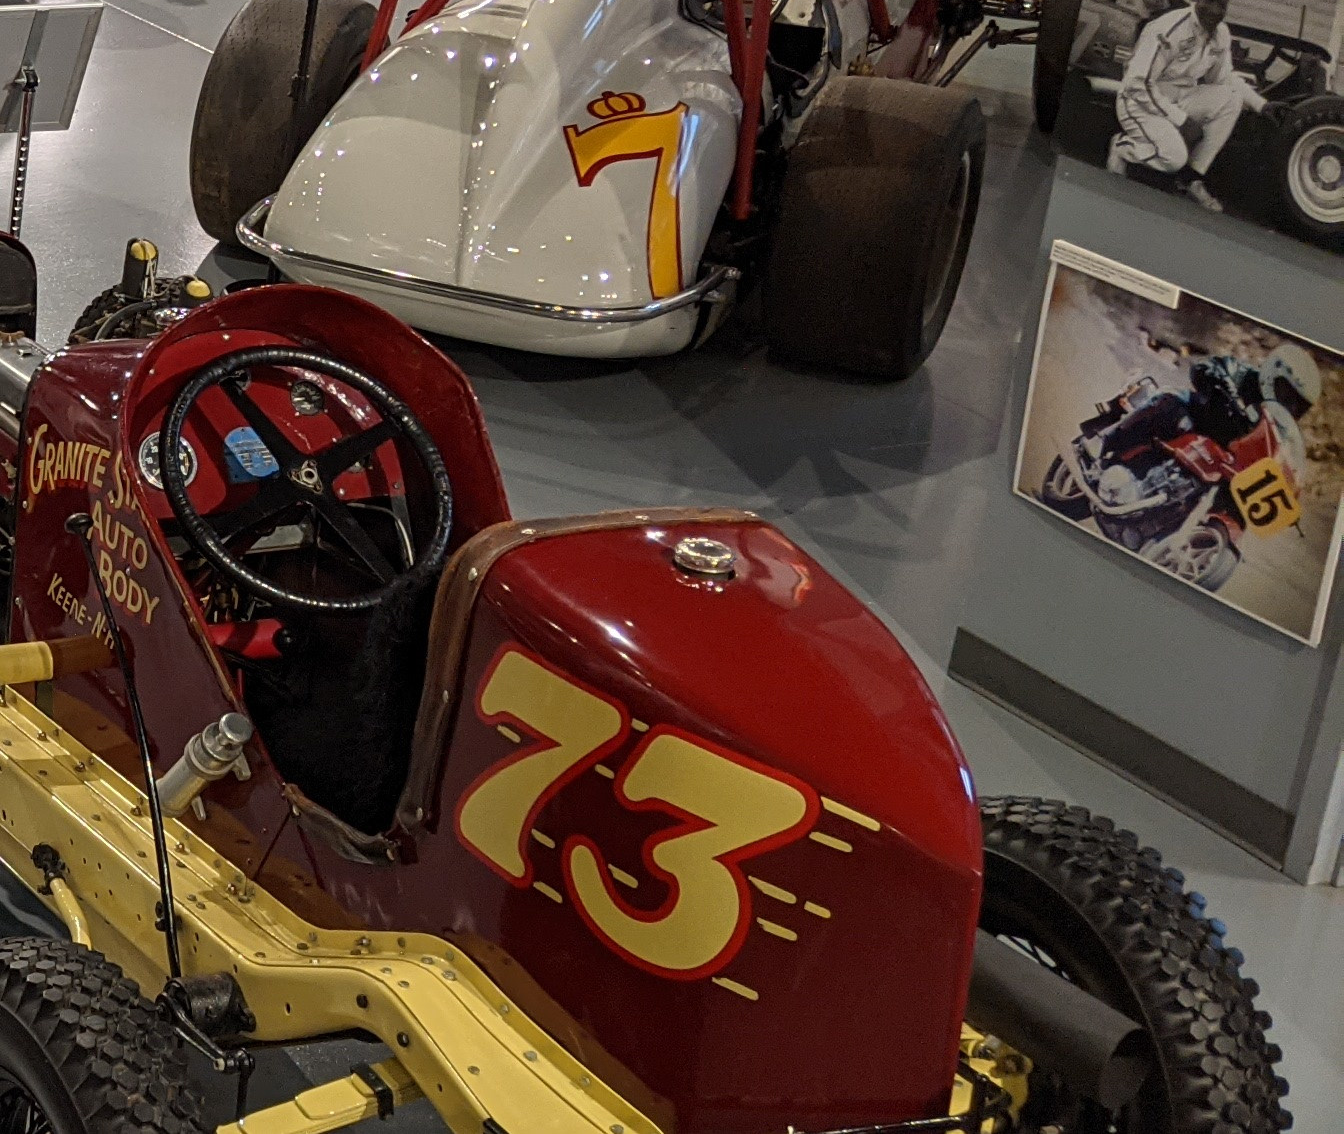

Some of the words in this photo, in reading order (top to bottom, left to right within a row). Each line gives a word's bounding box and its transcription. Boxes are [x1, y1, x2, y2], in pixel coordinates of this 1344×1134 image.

[563, 100, 689, 301] 7
[29, 424, 111, 494] GRANITE
[110, 449, 139, 511] STA
[1237, 468, 1294, 528] 15
[87, 501, 148, 570] AUTO
[47, 573, 86, 624] KEENE
[99, 550, 160, 624] BODY
[455, 641, 820, 982] 73
